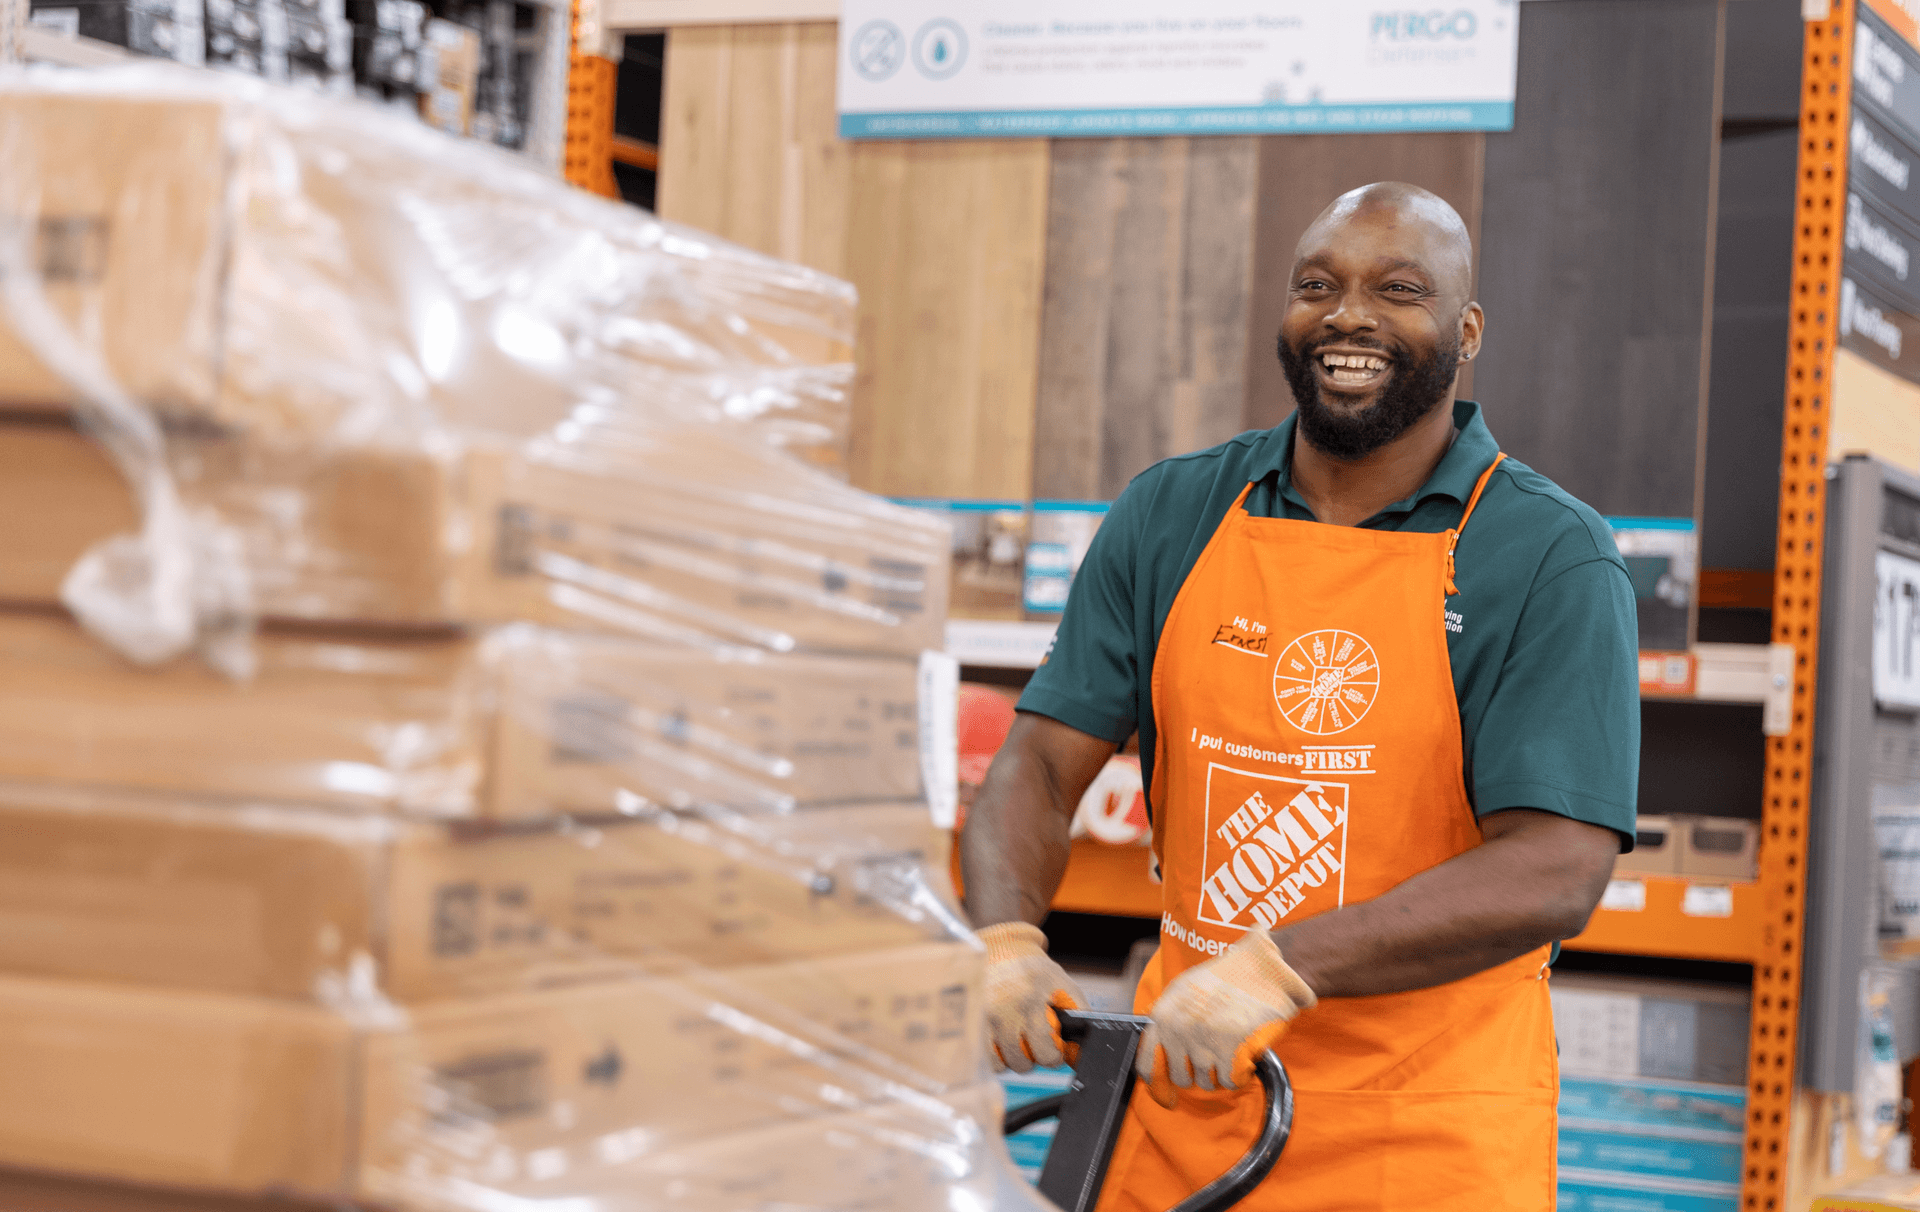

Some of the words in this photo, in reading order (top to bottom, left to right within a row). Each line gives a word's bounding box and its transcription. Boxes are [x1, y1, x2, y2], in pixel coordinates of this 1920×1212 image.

[1370, 12, 1478, 41] PERGO
[1233, 615, 1249, 632] Hi,
[1251, 621, 1267, 634] I'm
[1445, 609, 1462, 624] ving
[1445, 621, 1462, 633] tion
[1211, 624, 1273, 653] Ernest
[1191, 727, 1198, 742] I
[1199, 734, 1223, 750] put
[1225, 742, 1304, 766] customers
[1305, 751, 1371, 769] FIRST
[1216, 791, 1273, 850] THE
[1204, 782, 1345, 924] HOME
[1249, 841, 1342, 931] DEPOT
[1161, 910, 1187, 943] How
